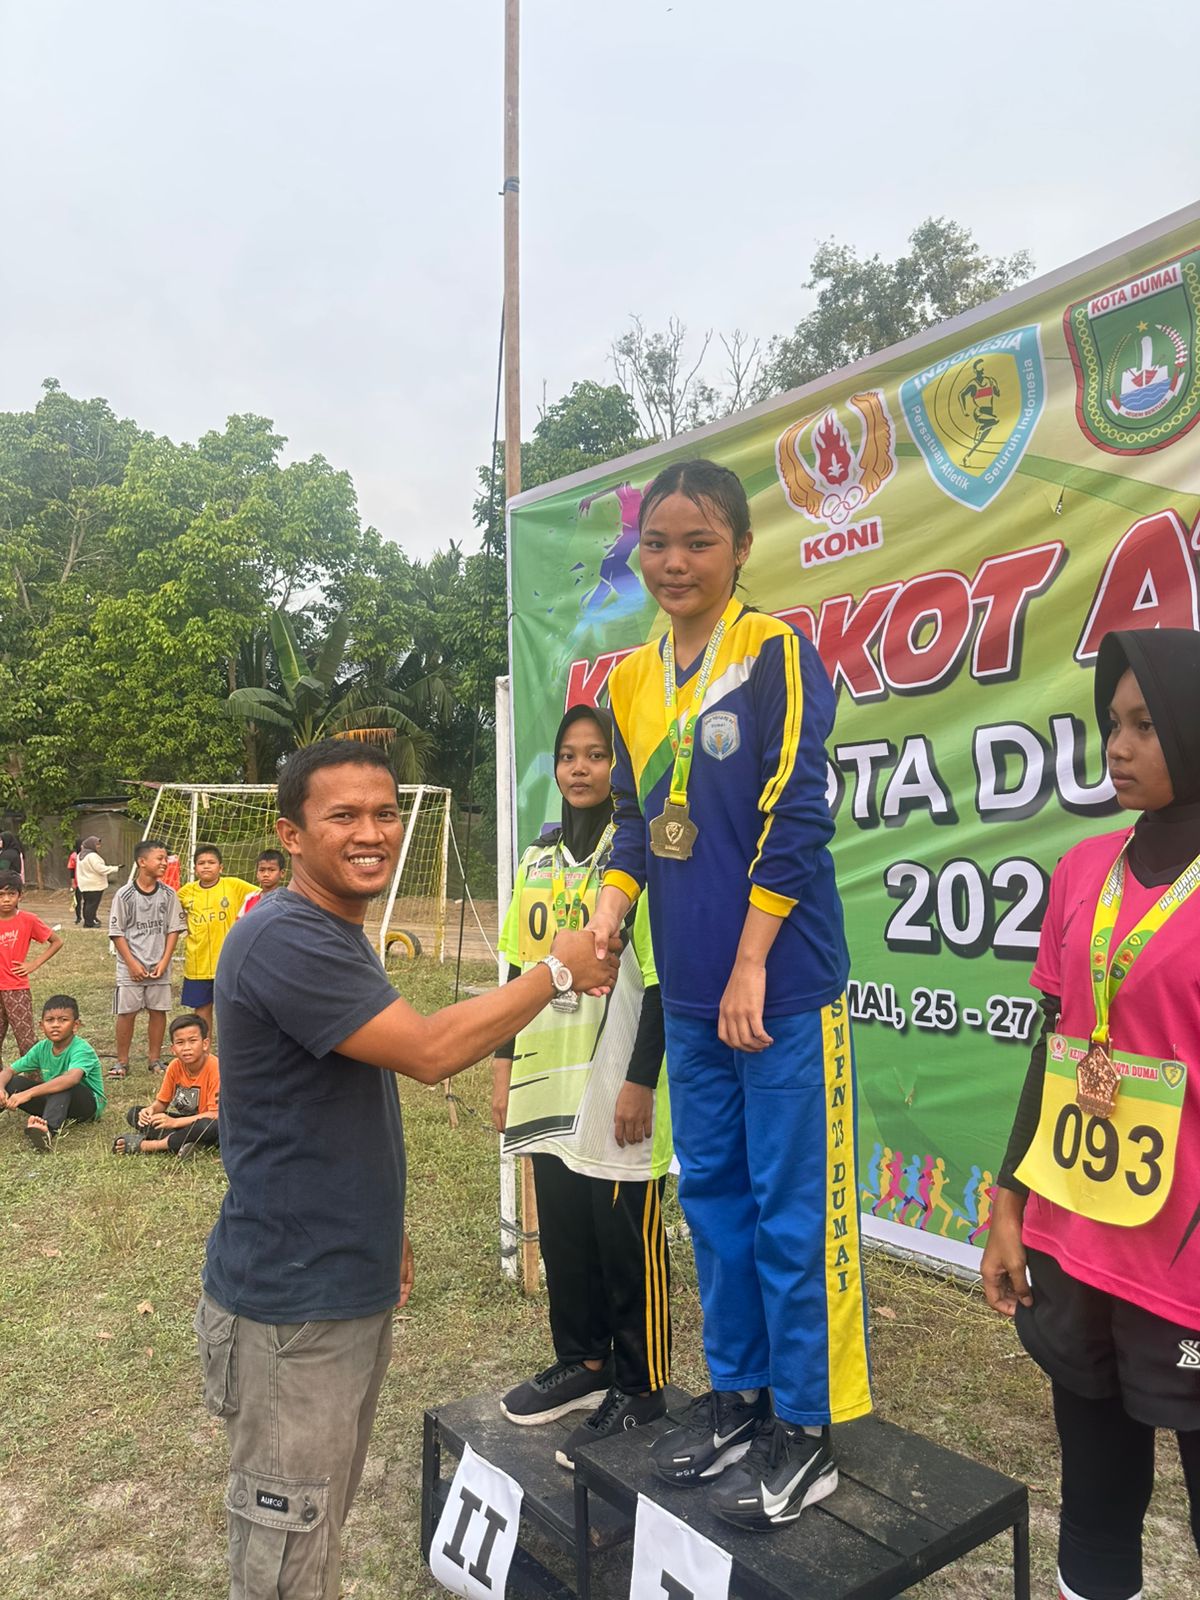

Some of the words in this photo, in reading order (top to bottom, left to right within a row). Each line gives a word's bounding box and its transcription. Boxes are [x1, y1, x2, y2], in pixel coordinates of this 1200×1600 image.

[1091, 289, 1127, 315] KOTA
[1131, 267, 1178, 298] DUMAI
[913, 332, 1024, 390] INDONESIA
[911, 405, 944, 466] Persatuan
[939, 461, 970, 491] Atletik
[984, 433, 1022, 484] Seluruh
[1019, 358, 1036, 432] Indonesia
[804, 522, 879, 563] KONI
[884, 860, 1043, 948] 202
[914, 991, 952, 1026] 25
[990, 998, 1032, 1035] 27
[1131, 1065, 1158, 1080] DUMAI
[832, 1119, 844, 1148] 23
[1053, 1103, 1164, 1196] 093
[832, 1162, 849, 1292] DUMAI
[442, 1486, 508, 1591] II
